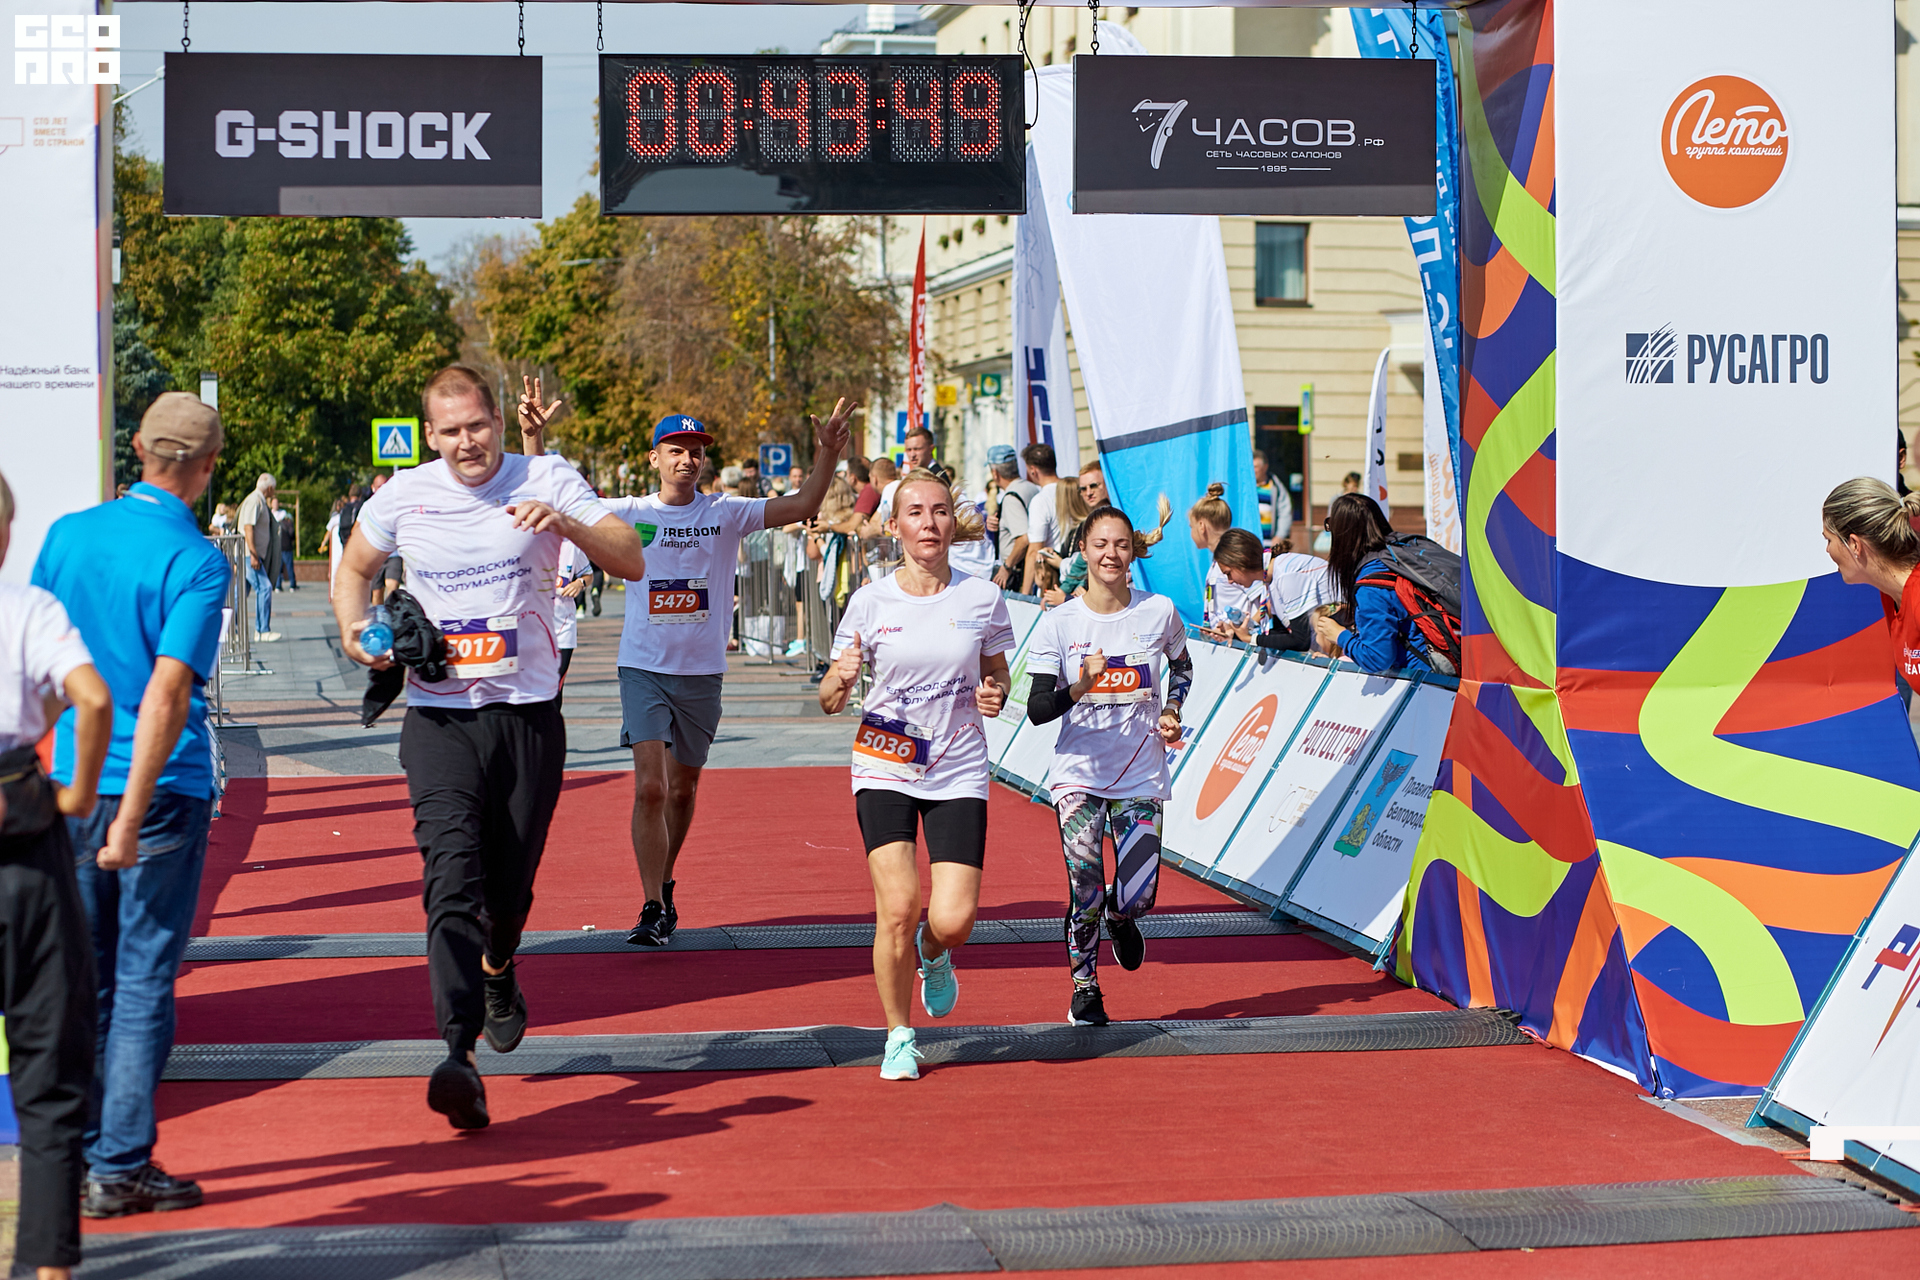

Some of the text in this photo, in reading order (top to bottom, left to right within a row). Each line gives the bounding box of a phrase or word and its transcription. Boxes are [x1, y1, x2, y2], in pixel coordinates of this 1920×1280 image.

[33, 117, 67, 125] СТО ЛЕТ
[626, 72, 999, 157] 00:43:49
[1670, 89, 1788, 155] Лето
[33, 128, 66, 136] ВМЕСТЕ
[215, 110, 491, 160] G-SHOCK
[47, 138, 85, 146] СТРАНОЙ
[1206, 150, 1342, 159] СЕТЬ ЧАСОВЫХ САЛОНОВ
[1686, 145, 1783, 160] группа компаний
[1260, 165, 1287, 173] 1995
[1687, 333, 1829, 385] РУСАГРО
[0, 364, 91, 376] Надёжный банк
[0, 381, 95, 391] нашего времени
[663, 525, 721, 538] FREEDOM
[660, 538, 700, 548] finance
[653, 593, 697, 609] 5479
[446, 636, 502, 659] 5017
[1096, 671, 1137, 688] 290
[860, 730, 912, 757] 5036
[1371, 829, 1404, 853] области
